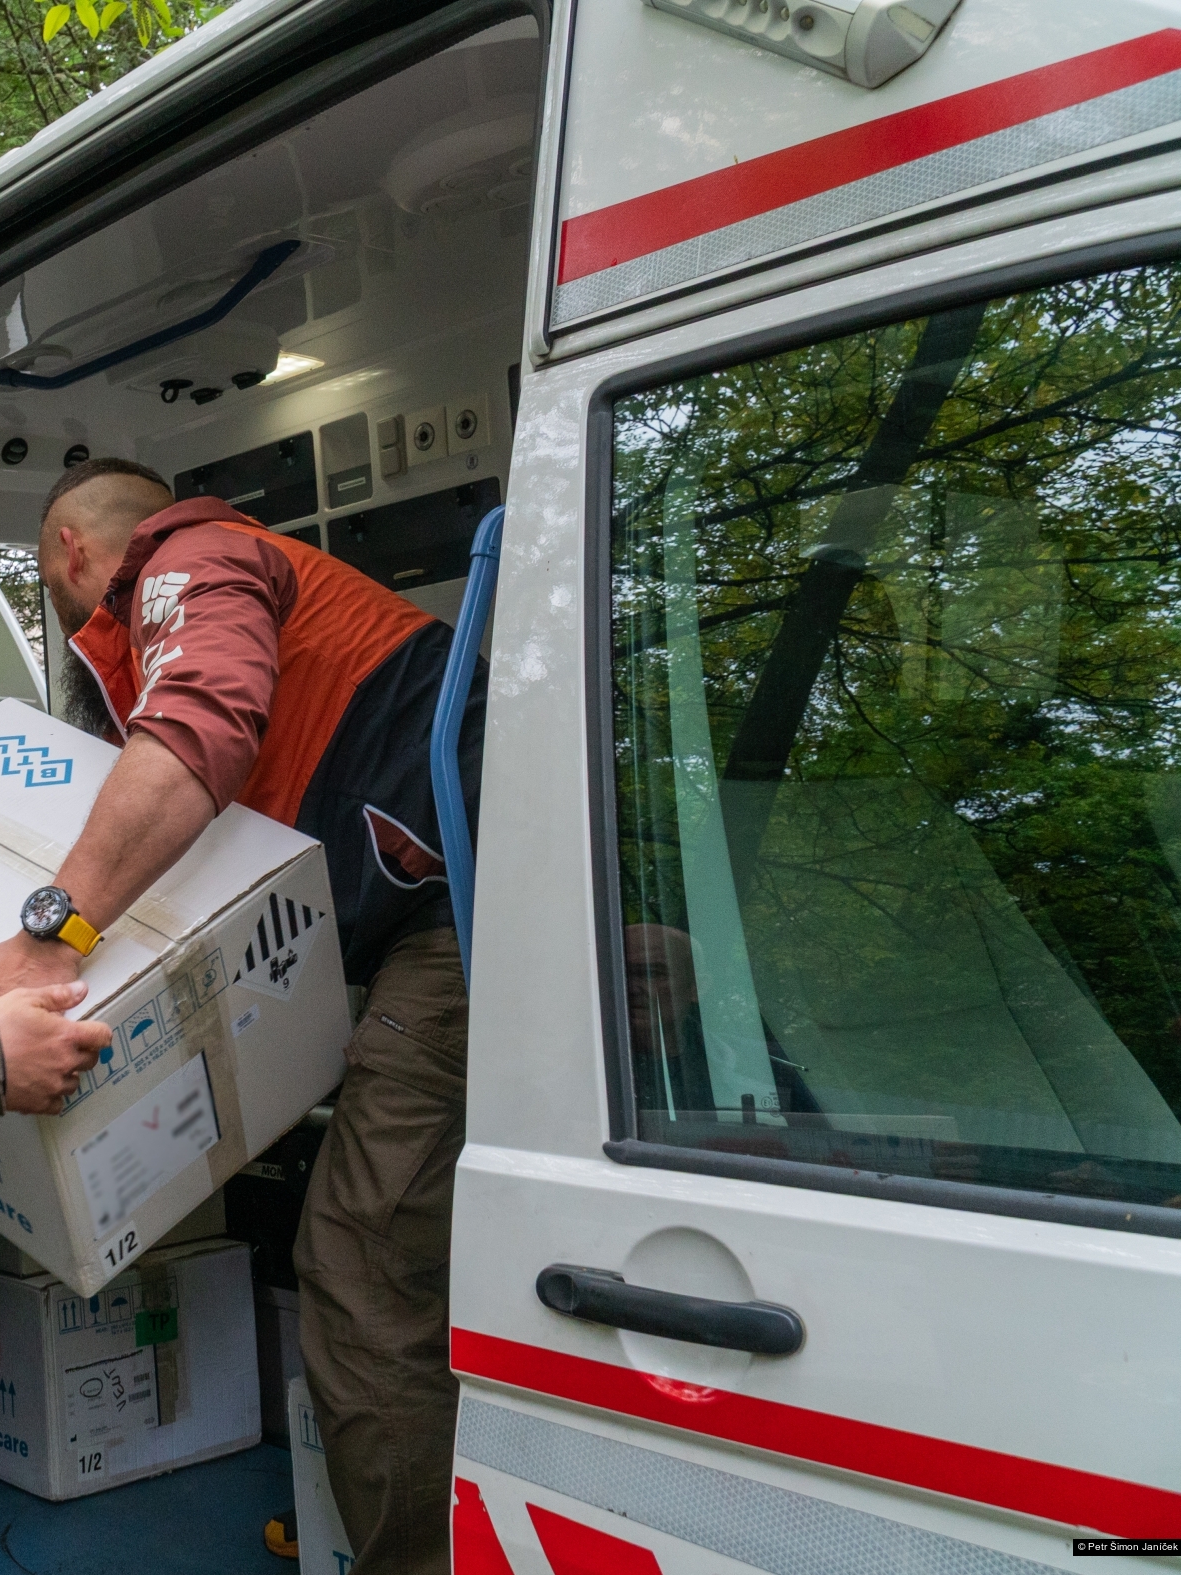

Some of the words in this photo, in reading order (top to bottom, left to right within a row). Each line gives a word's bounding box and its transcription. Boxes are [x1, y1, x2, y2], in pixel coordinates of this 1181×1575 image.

[282, 977, 290, 989] 9
[104, 1230, 139, 1267] 1/2
[149, 1313, 170, 1331] TP
[79, 1452, 102, 1474] 1/2
